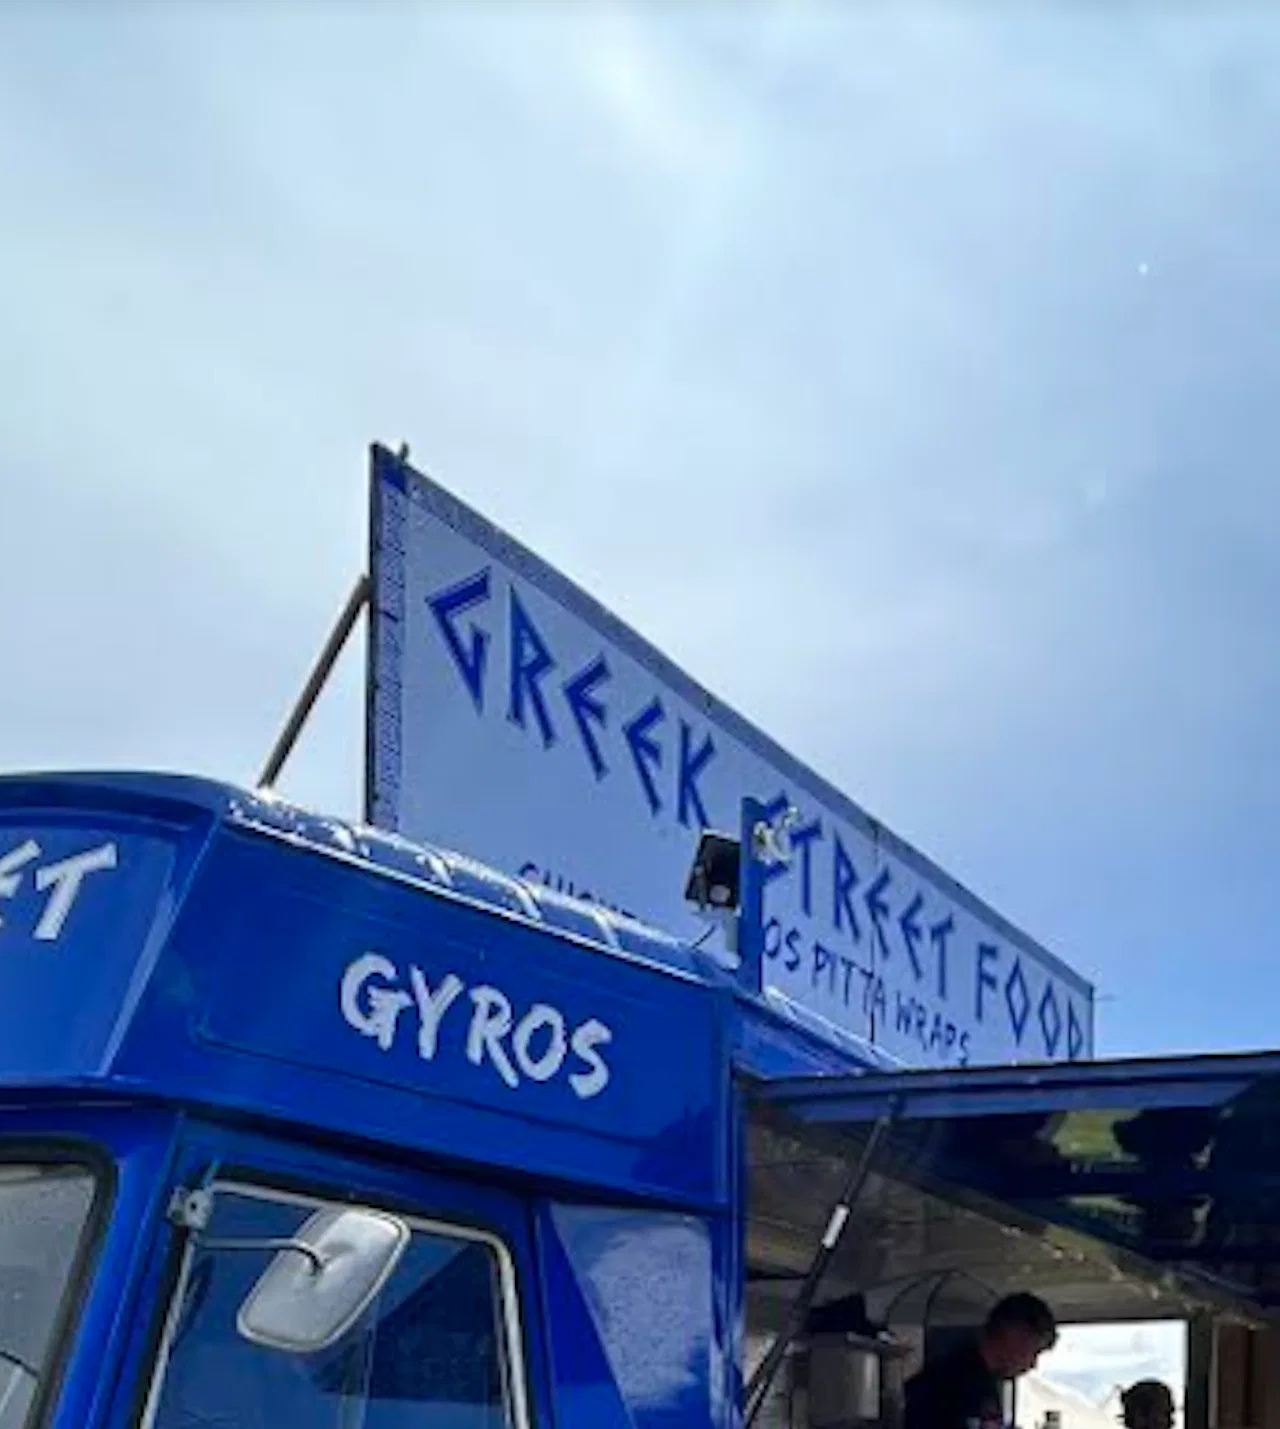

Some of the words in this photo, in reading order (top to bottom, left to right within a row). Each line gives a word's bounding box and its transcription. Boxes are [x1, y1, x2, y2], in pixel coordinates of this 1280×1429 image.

[425, 565, 716, 830] GREEK
[976, 940, 1084, 1060] FOOD
[340, 951, 613, 1099] GYROS
[811, 940, 888, 1028] PITTA
